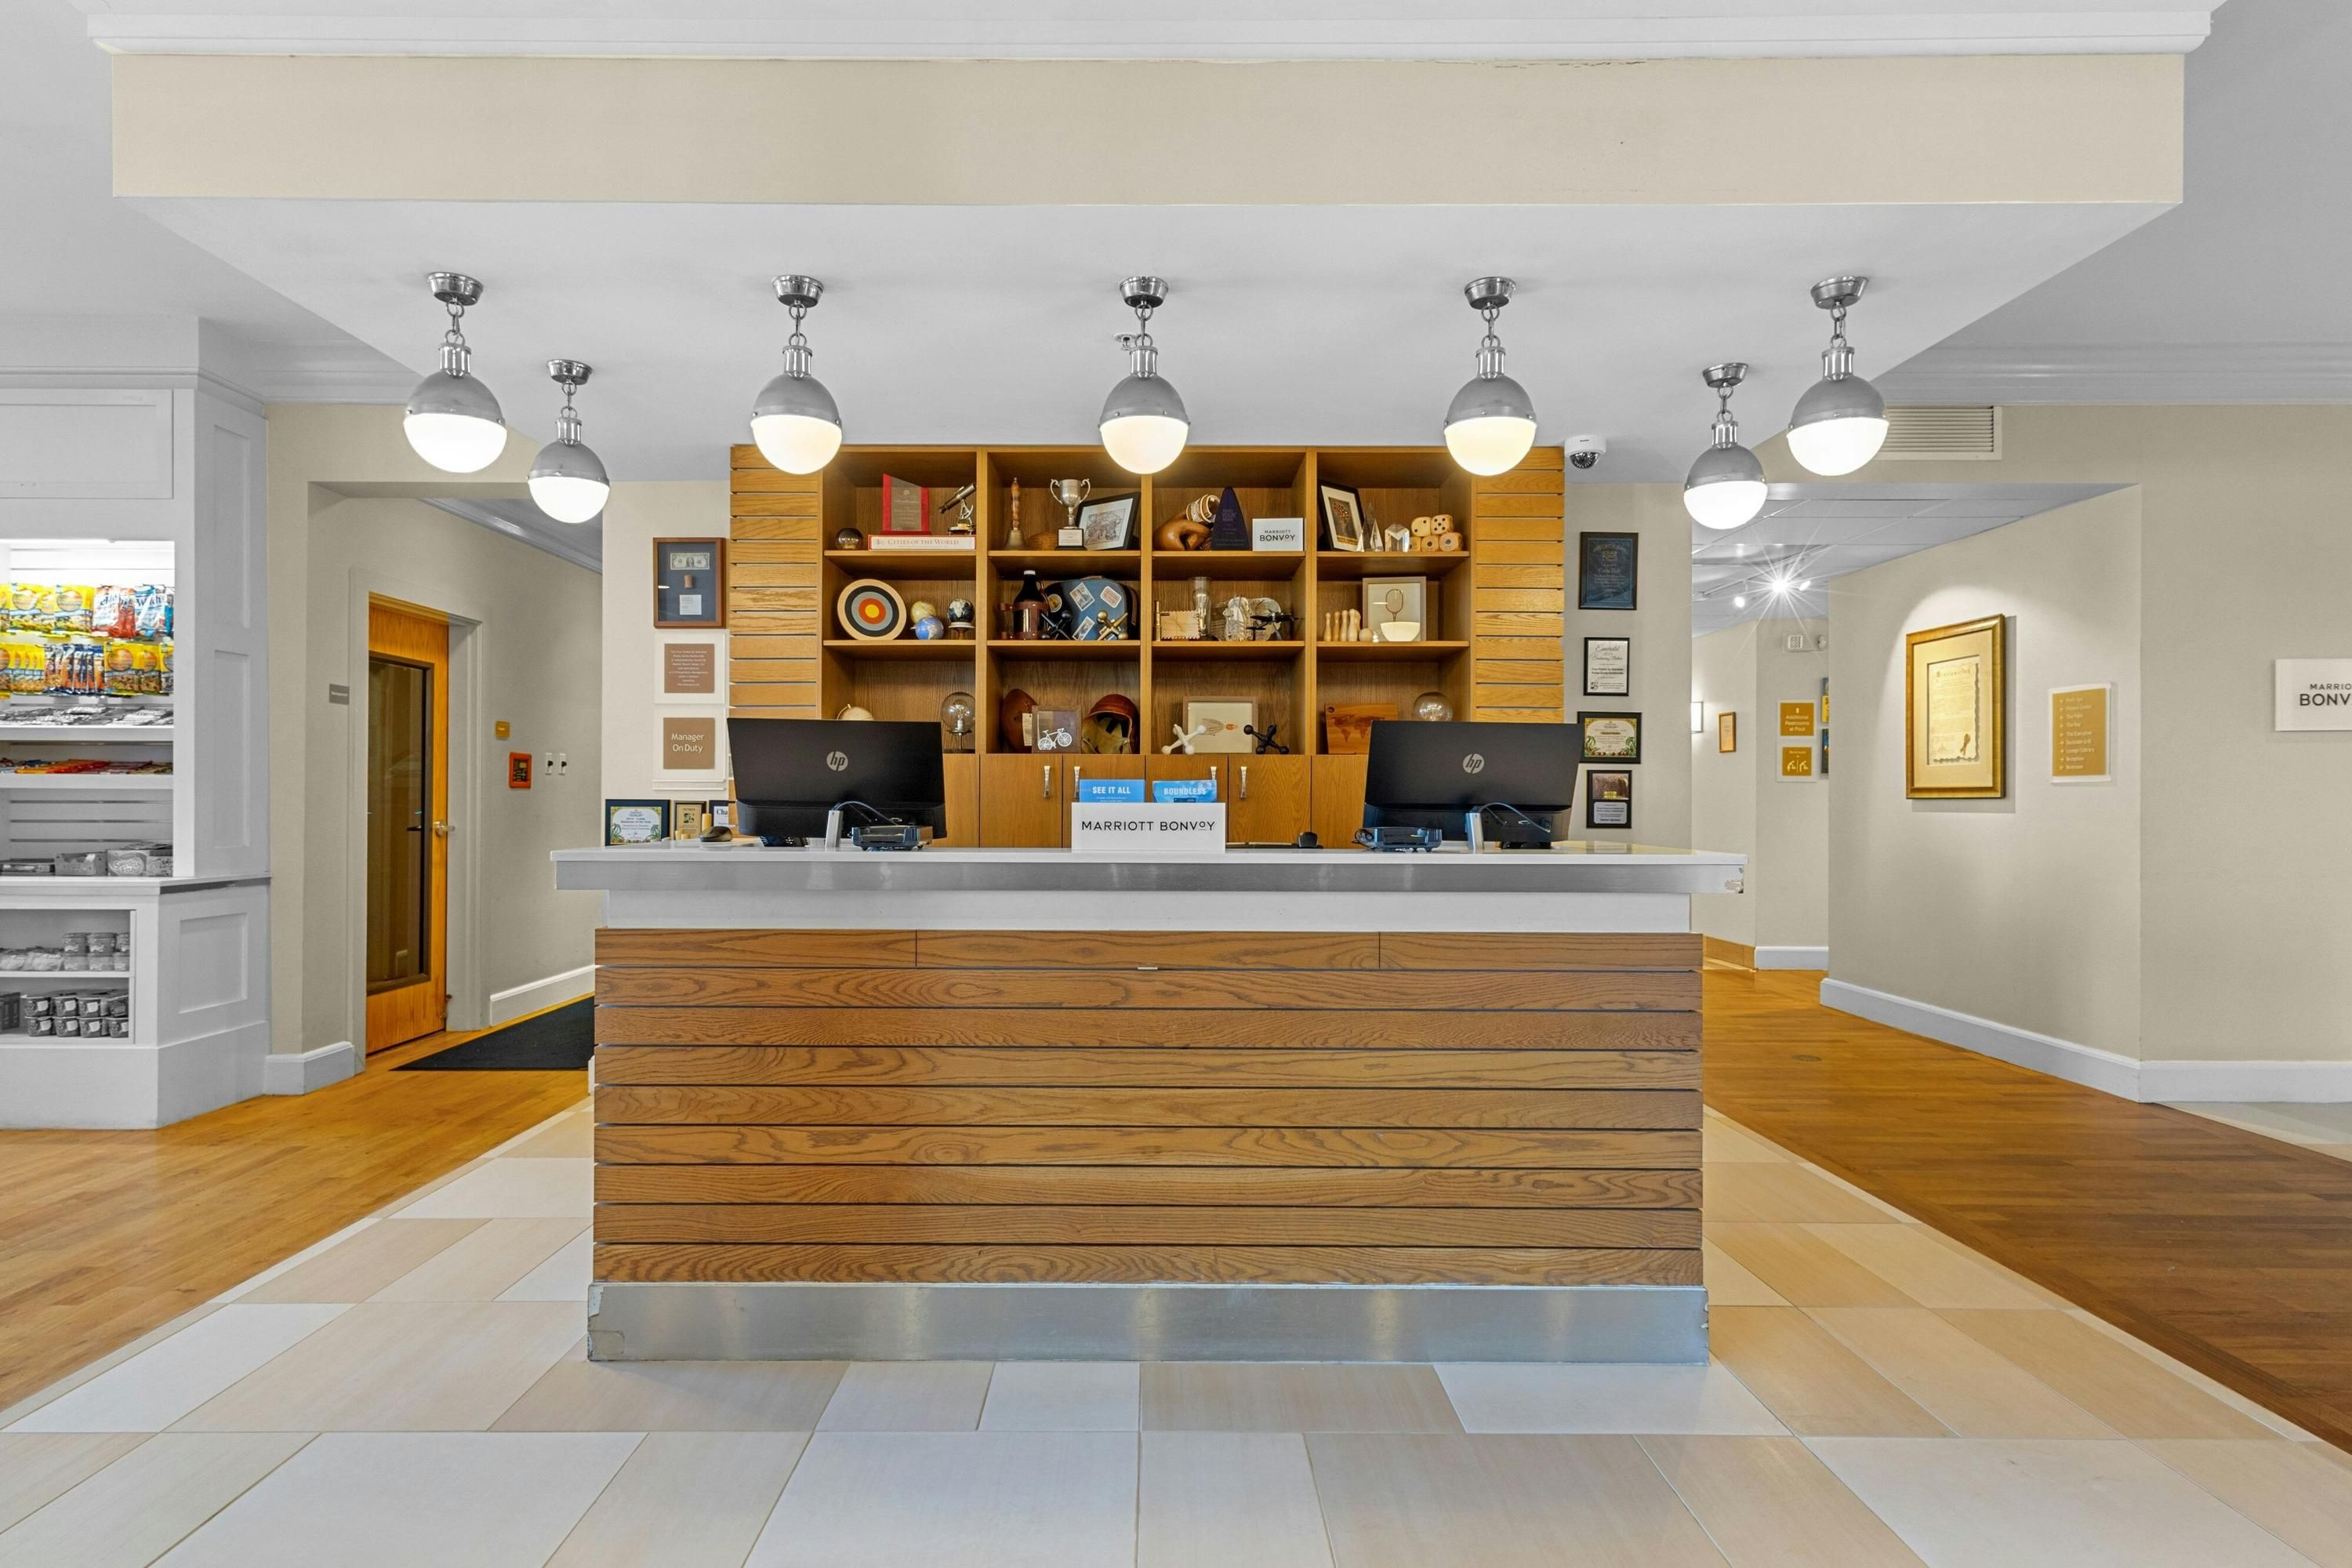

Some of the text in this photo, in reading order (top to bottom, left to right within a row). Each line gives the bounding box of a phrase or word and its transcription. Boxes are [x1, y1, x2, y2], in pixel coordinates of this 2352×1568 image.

[671, 733, 705, 742] Manager
[673, 743, 703, 753] On Duty
[829, 751, 847, 771] hp
[1465, 753, 1483, 774] hp
[1081, 821, 1154, 831] MARRIOTT
